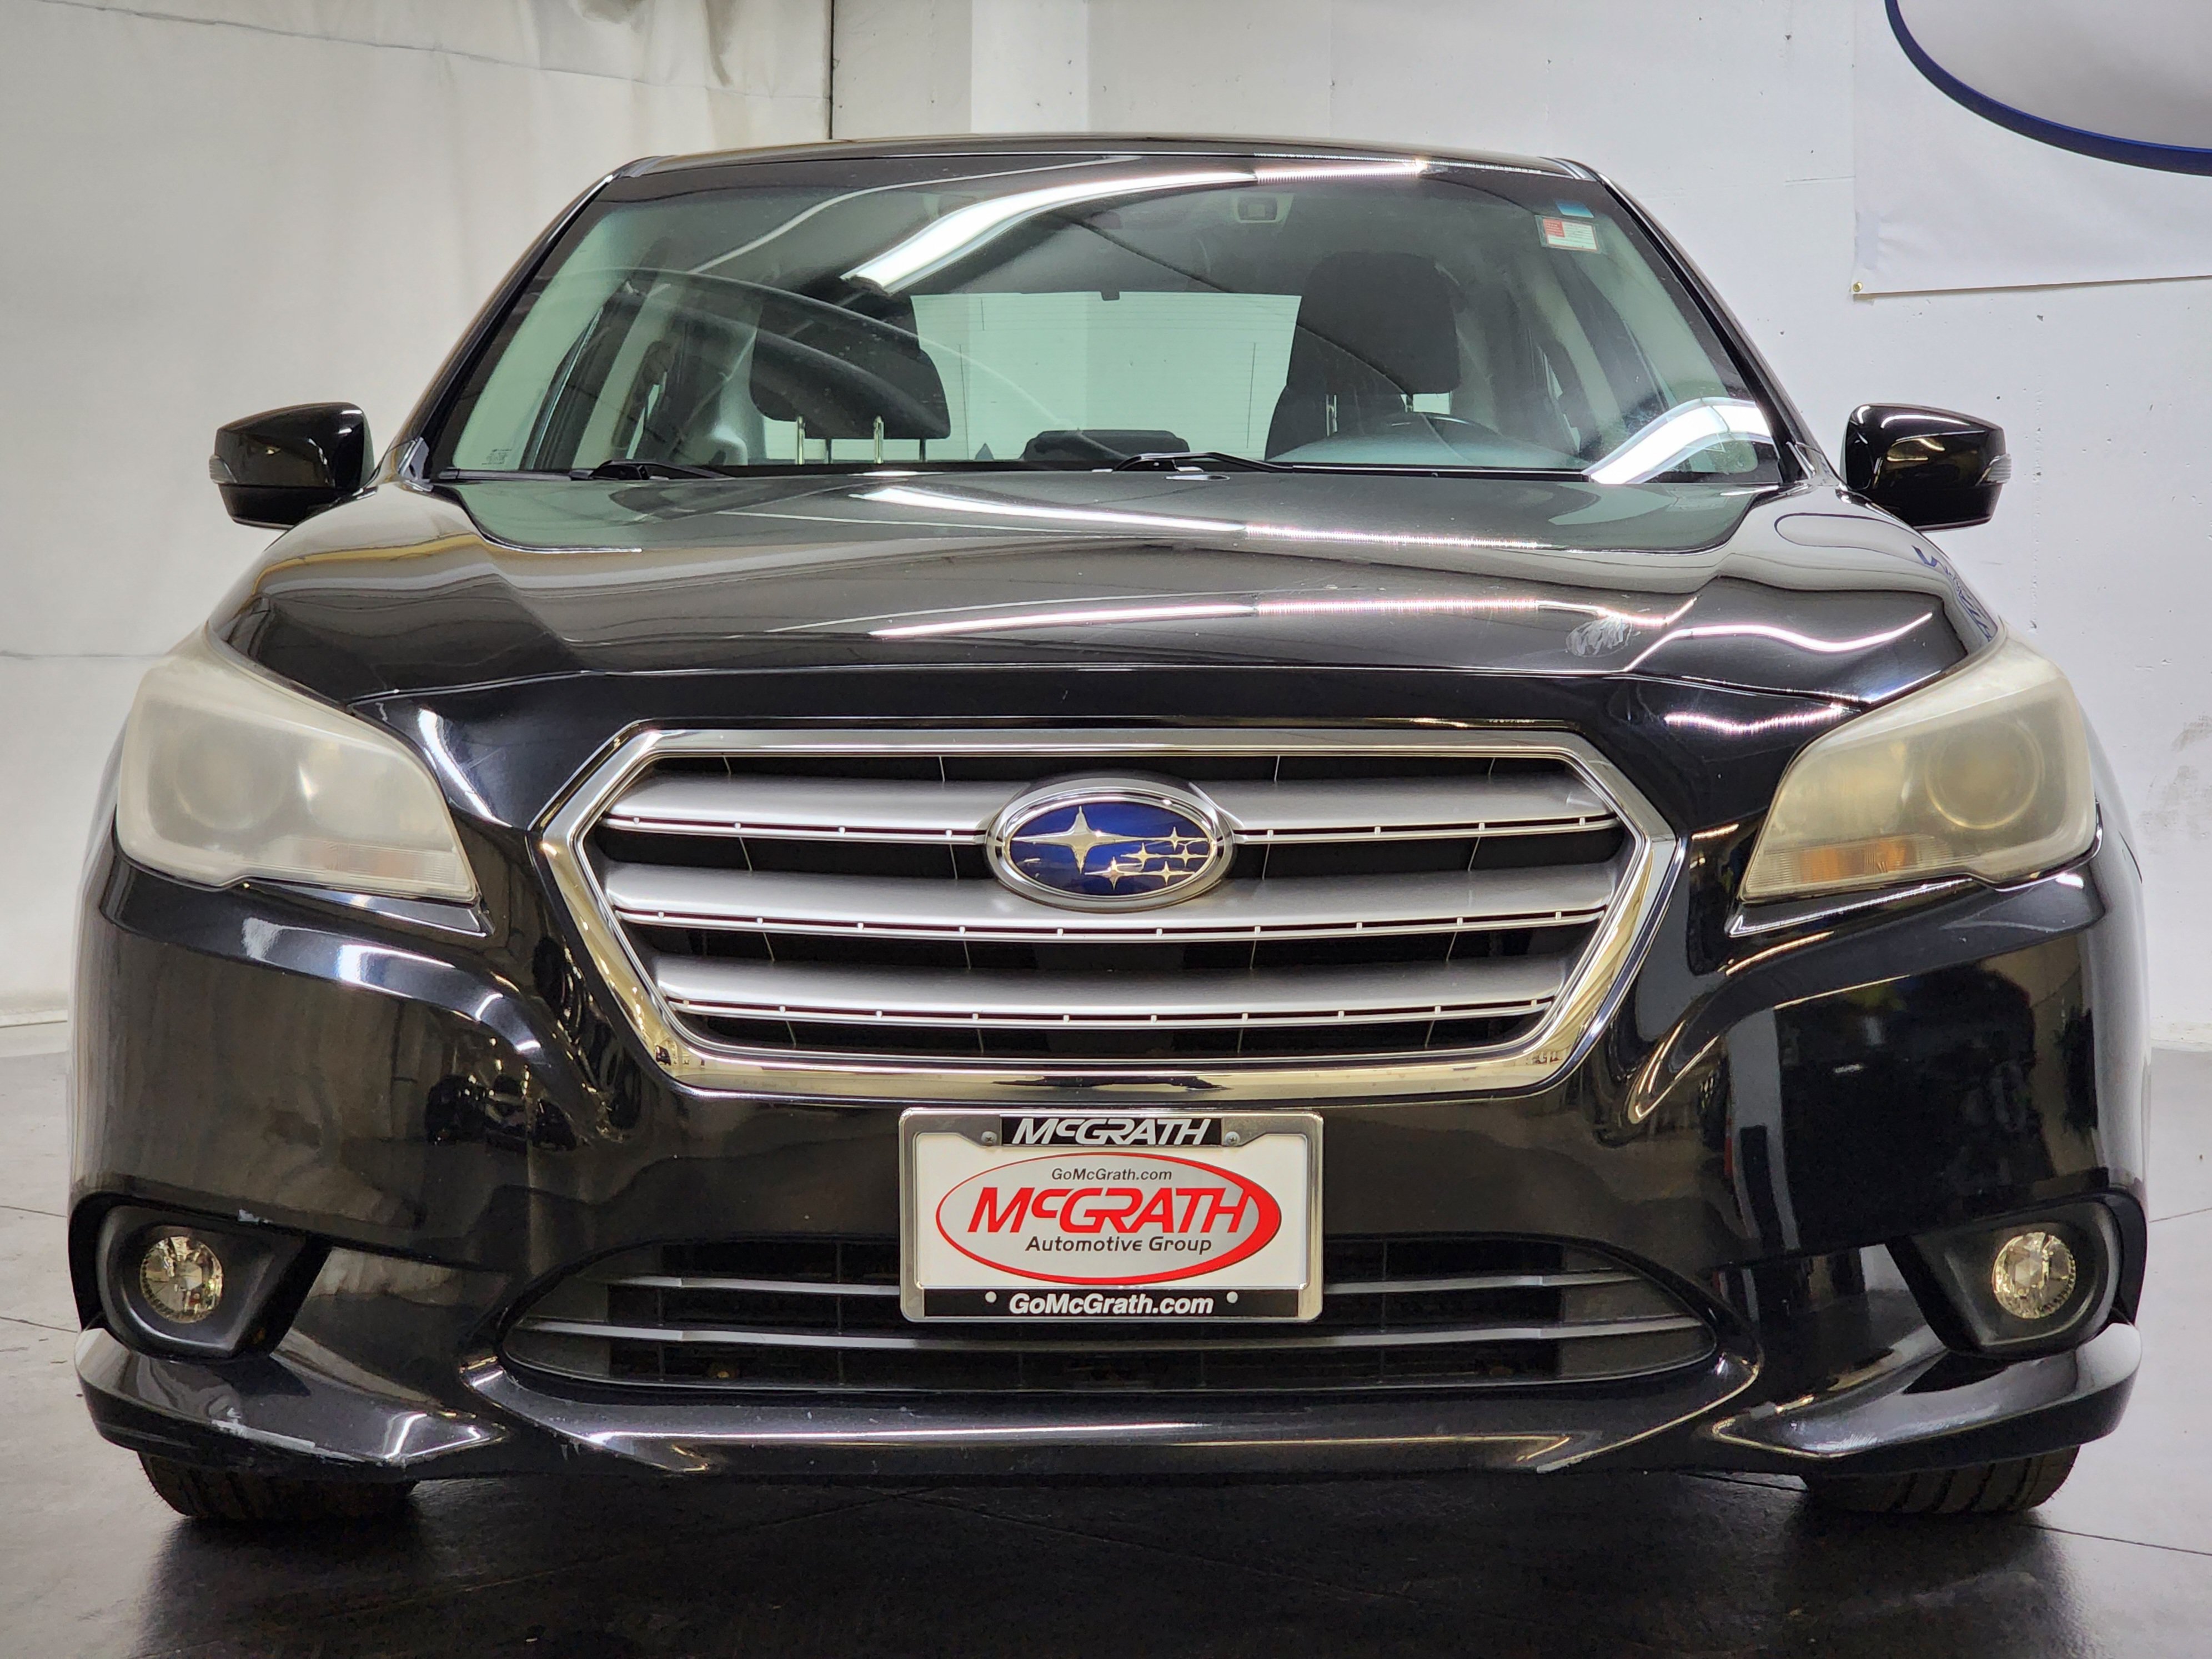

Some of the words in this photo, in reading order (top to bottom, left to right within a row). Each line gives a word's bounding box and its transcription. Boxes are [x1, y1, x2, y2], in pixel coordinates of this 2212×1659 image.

[1051, 1168, 1172, 1181] GoMcGrath.com
[1025, 1236, 1142, 1252] Automotive
[1148, 1236, 1212, 1255] Group
[1009, 1293, 1214, 1315] GoMcGrath.com
